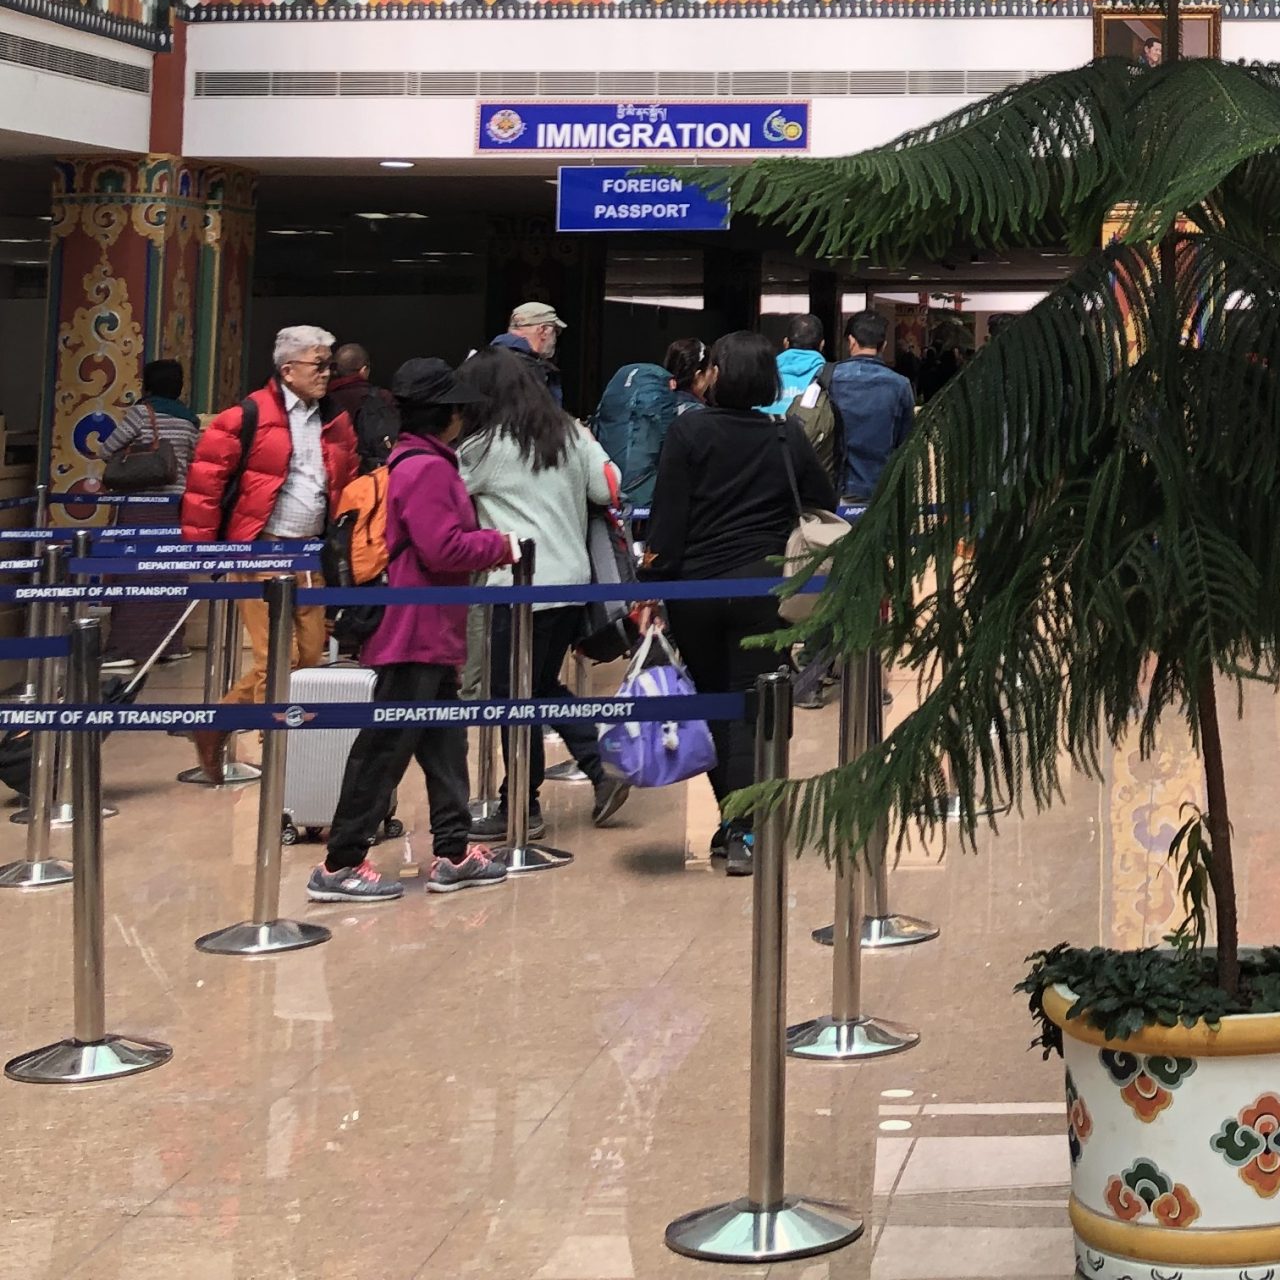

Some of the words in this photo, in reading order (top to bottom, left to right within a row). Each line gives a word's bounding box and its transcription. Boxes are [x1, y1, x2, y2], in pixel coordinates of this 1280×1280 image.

[536, 123, 751, 148] IMMIGRATION
[602, 179, 682, 193] FOREIGN
[594, 204, 690, 219] PASSPORT
[101, 528, 136, 537] AIRPORT
[156, 545, 193, 553] AIRPORT
[195, 545, 252, 553] IMMIGRATION
[138, 561, 202, 570] DEPARTMENT
[203, 560, 216, 569] OF
[217, 560, 235, 569] AIR
[236, 560, 293, 568] TRANSPORT
[16, 587, 87, 598] DEPARTMENT
[88, 587, 103, 596] OF
[104, 587, 124, 596] AIR
[126, 586, 189, 596] TRANSPORT
[59, 710, 83, 724] OF
[86, 710, 115, 723] AIR
[118, 709, 216, 724] TRANSPORT
[373, 706, 481, 723] DEPARTMENT
[483, 705, 506, 719] OF
[508, 705, 535, 719] AIR
[540, 702, 634, 718] TRANSPORT
